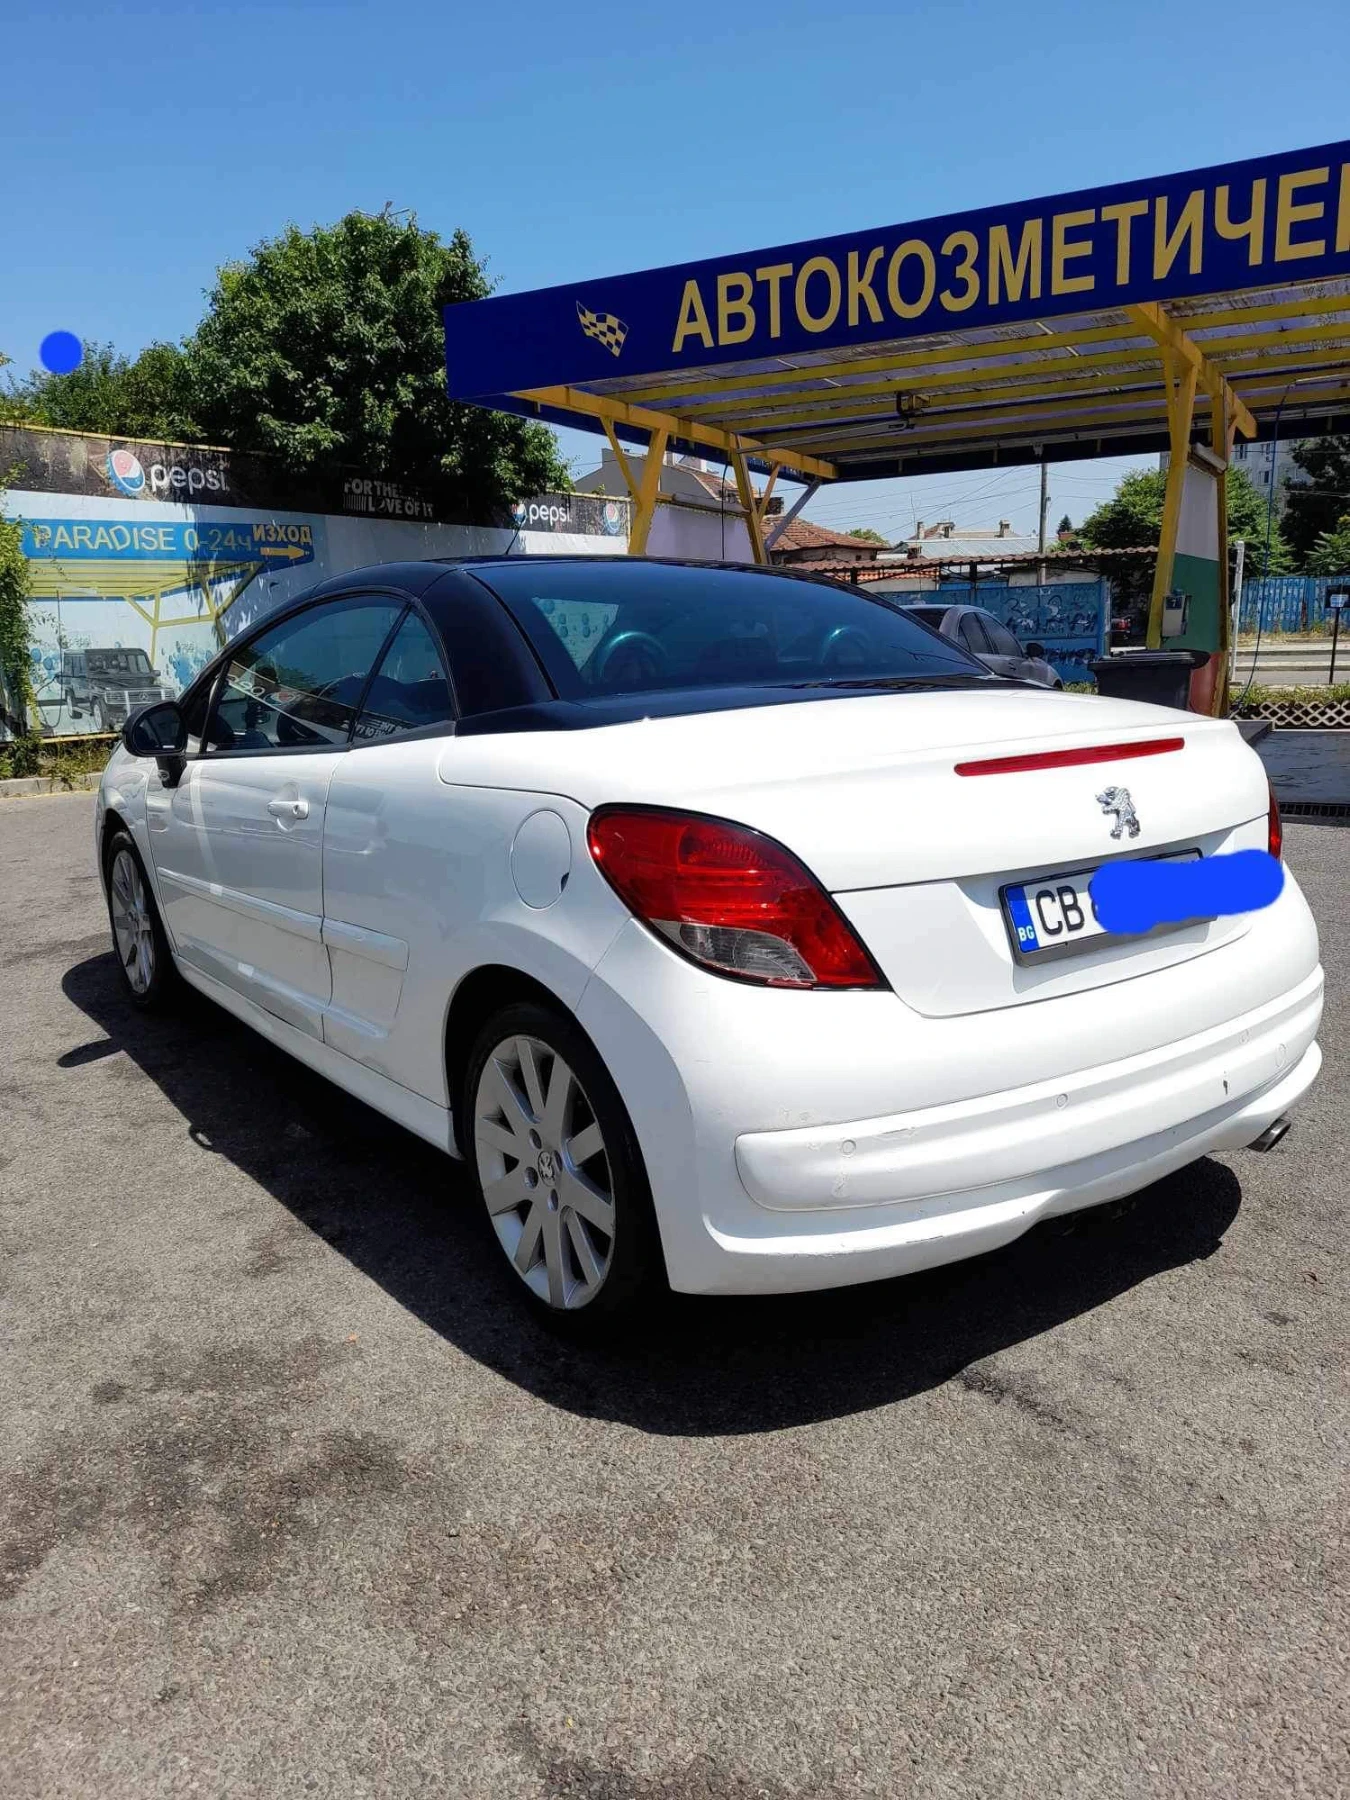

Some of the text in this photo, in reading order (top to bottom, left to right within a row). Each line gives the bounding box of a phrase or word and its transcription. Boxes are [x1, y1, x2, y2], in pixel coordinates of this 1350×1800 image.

[151, 463, 226, 495] pepsi
[374, 480, 399, 498] THE
[405, 500, 420, 516] OF
[529, 503, 571, 526] pepsi
[35, 524, 176, 550] PARADISE
[252, 524, 312, 546] ИЗХОД
[1036, 885, 1085, 935] CB
[1018, 925, 1035, 941] BG
